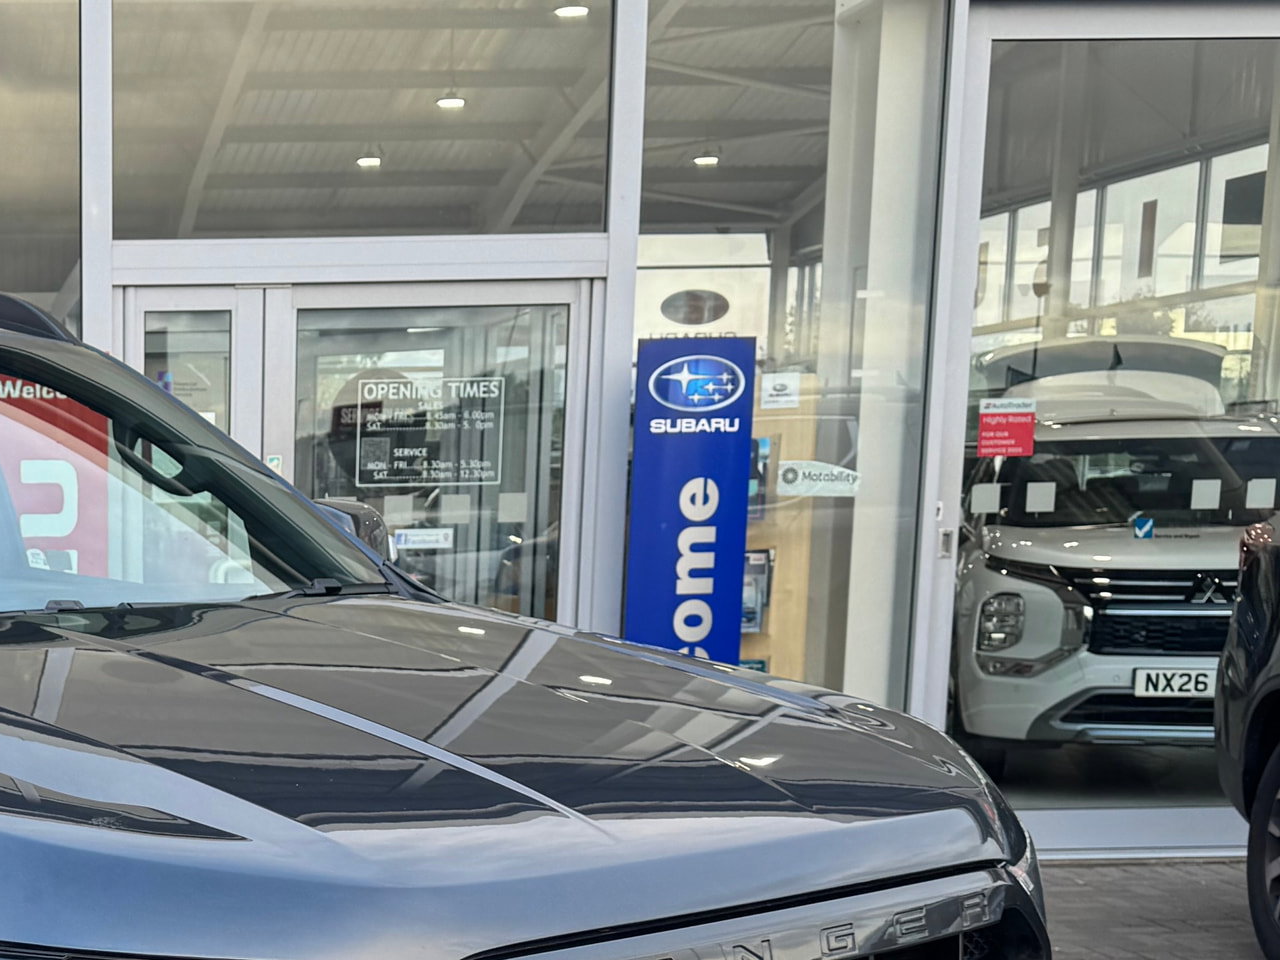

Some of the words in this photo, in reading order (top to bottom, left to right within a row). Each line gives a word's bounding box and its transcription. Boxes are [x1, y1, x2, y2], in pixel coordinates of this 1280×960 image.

[363, 382, 443, 400] OPENING
[447, 381, 500, 399] TIMES
[650, 417, 739, 433] SUBARU
[393, 447, 428, 457] SERVICE
[801, 470, 858, 484] Motability
[1145, 672, 1209, 692] NX26
